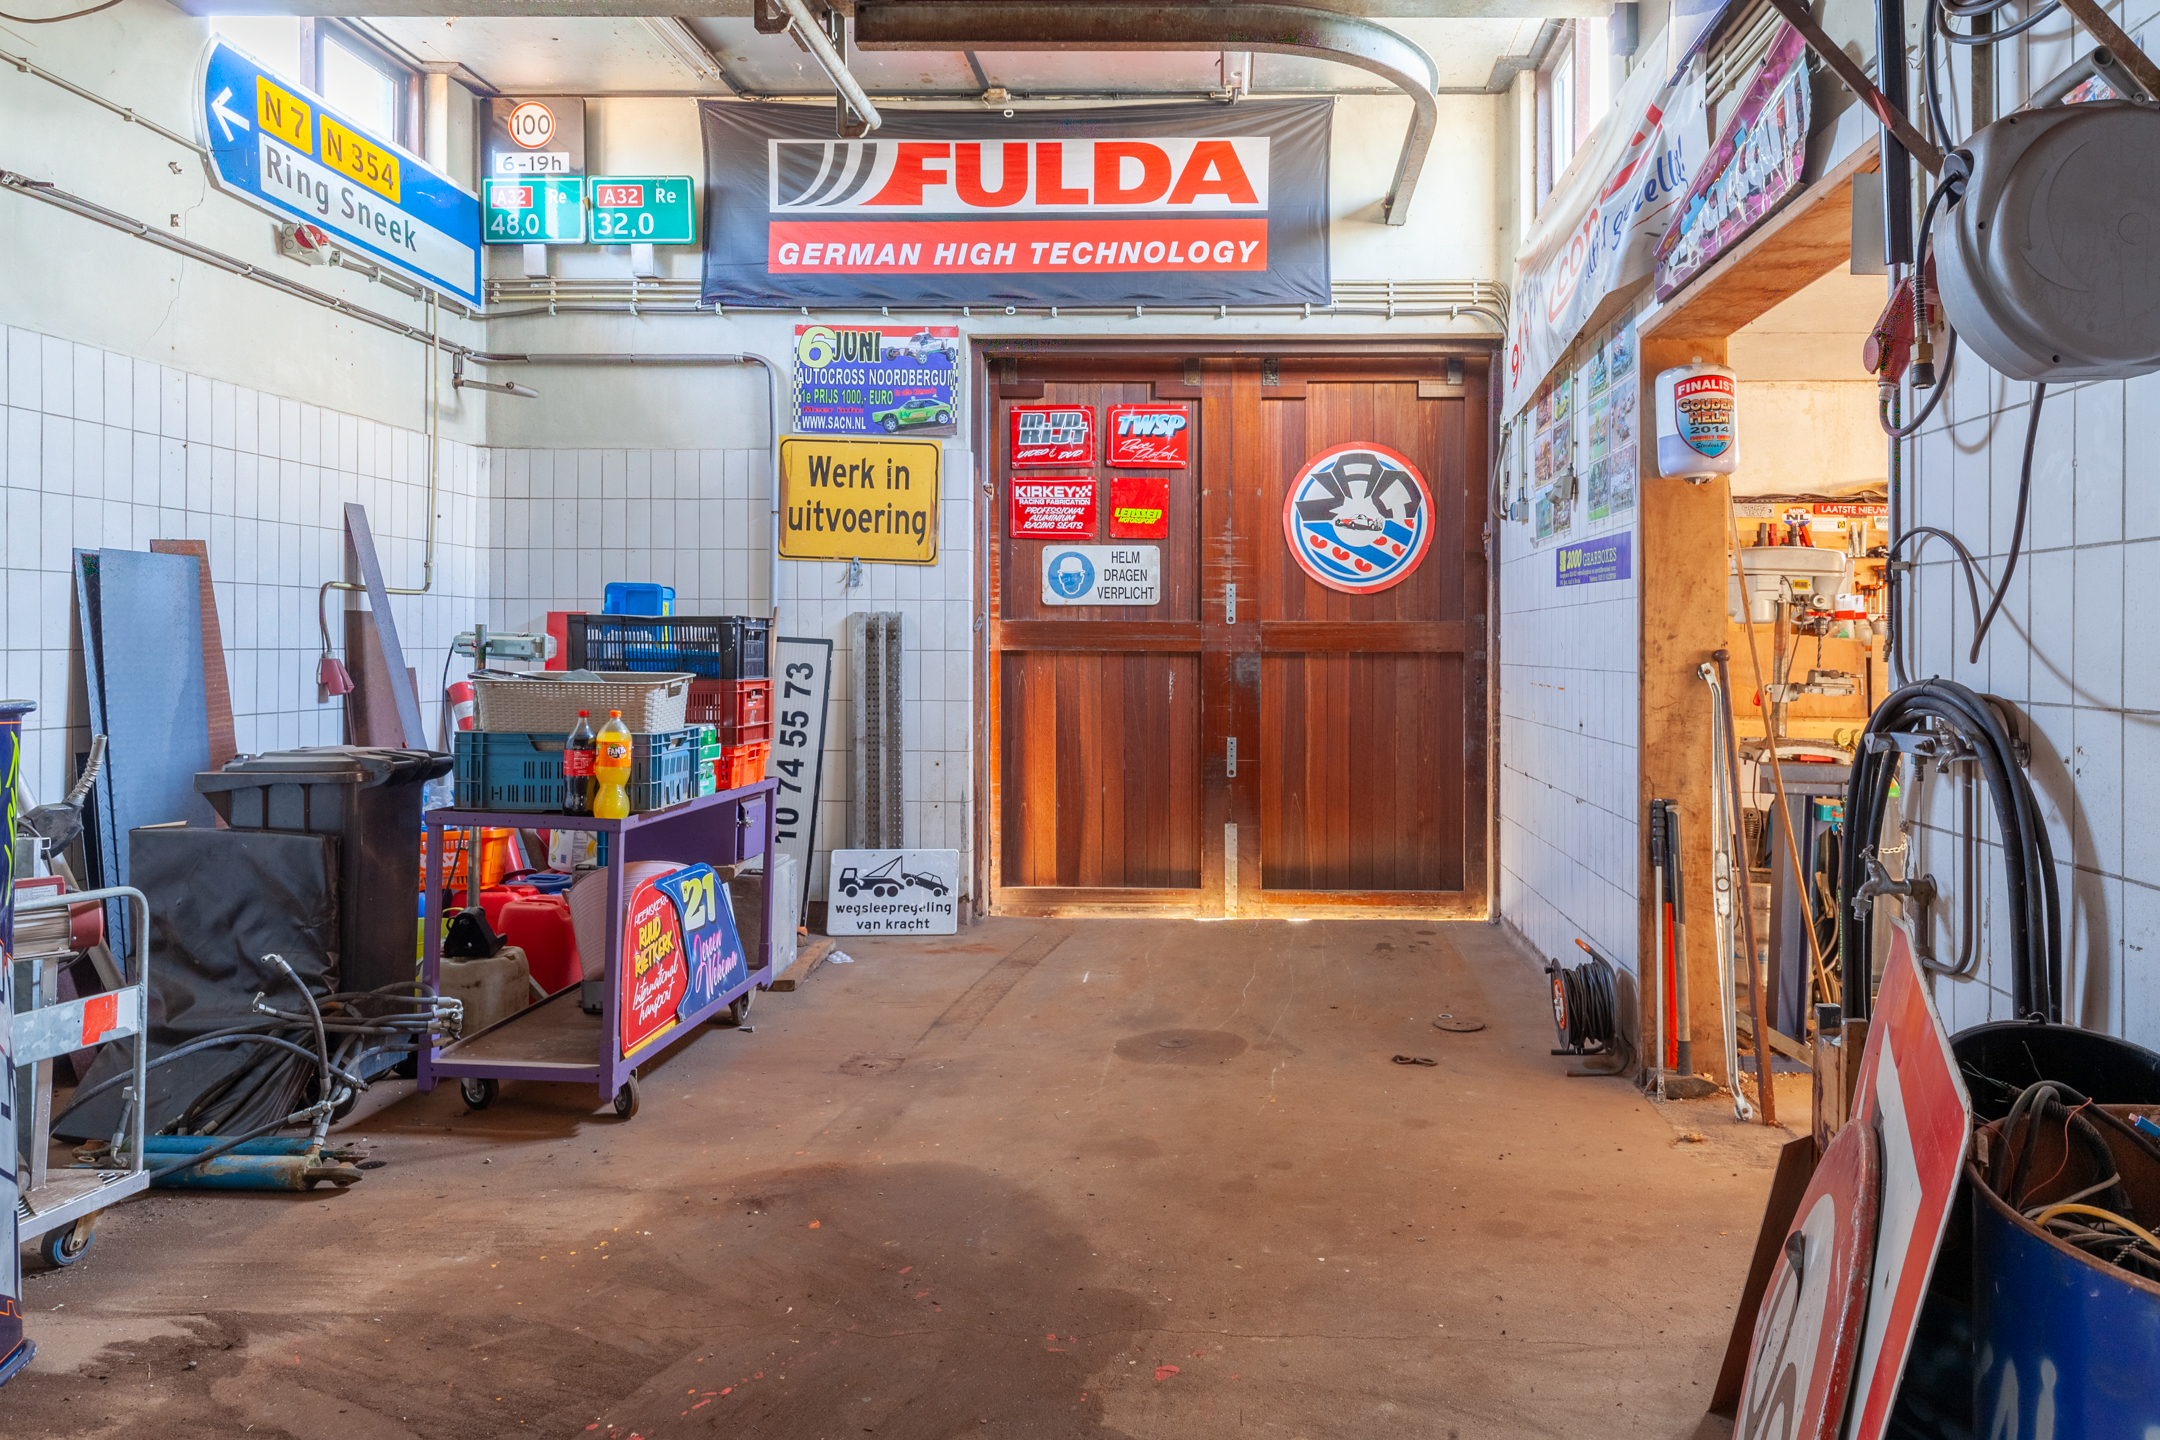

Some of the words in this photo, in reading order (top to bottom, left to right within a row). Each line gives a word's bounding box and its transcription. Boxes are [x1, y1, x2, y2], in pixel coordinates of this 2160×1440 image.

[265, 91, 281, 128] N
[291, 109, 304, 139] 7
[514, 114, 550, 135] 100
[327, 128, 342, 163] N
[351, 143, 394, 190] 354
[859, 140, 1260, 208] FULDA
[266, 145, 329, 215] Ring
[341, 187, 416, 252] Sneek
[497, 189, 526, 204] A32
[549, 190, 567, 204] Re
[603, 188, 638, 204] A32
[655, 188, 676, 203] Re
[490, 214, 540, 237] 48,0
[597, 212, 654, 238] 32,0
[778, 242, 922, 266] GERMAN
[933, 242, 1017, 266] HIGH
[1031, 239, 1260, 265] TECHNOLOGY
[798, 326, 836, 368] 6
[832, 331, 882, 363] JUNI
[797, 368, 865, 385] AUTOCROSS
[869, 368, 955, 387] NOORDBERGUM
[1677, 379, 1734, 396] FINALIST
[801, 389, 811, 403] 1e
[813, 388, 838, 404] PRIJS
[869, 389, 893, 405] EURO
[1678, 397, 1734, 413] GOUDEN
[802, 415, 866, 430] WWW.SACN.NL
[1117, 413, 1188, 437] TWSP
[1689, 410, 1729, 425] HELM
[1690, 425, 1729, 434] 2014
[1017, 448, 1050, 459] VIDEO
[1058, 449, 1084, 459] DVD
[808, 455, 875, 489] Werk
[887, 458, 910, 490] in
[1015, 485, 1076, 498] KIRKEY
[1024, 506, 1085, 515] PROFESSIONAL
[1114, 508, 1162, 519] LENSSEN
[1821, 505, 1857, 514] LAATSTE
[1858, 506, 1889, 514] NIEUW
[788, 499, 926, 546] uitvoering
[1023, 521, 1055, 529] RACING
[1056, 521, 1084, 529] SEATS
[1118, 516, 1158, 524] MOTORSPORT
[1111, 551, 1140, 564] HELM
[1104, 569, 1148, 581] DRAGEN
[1097, 586, 1155, 600] VERPLICHT
[783, 662, 814, 699] 73
[779, 710, 810, 748] 55
[681, 871, 716, 932] 21
[835, 902, 952, 916] wegsleepregeling
[856, 920, 881, 930] van
[886, 917, 931, 930] kracht
[638, 915, 662, 951] RUUD
[632, 949, 680, 1011] International
[635, 977, 676, 1026] Transport
